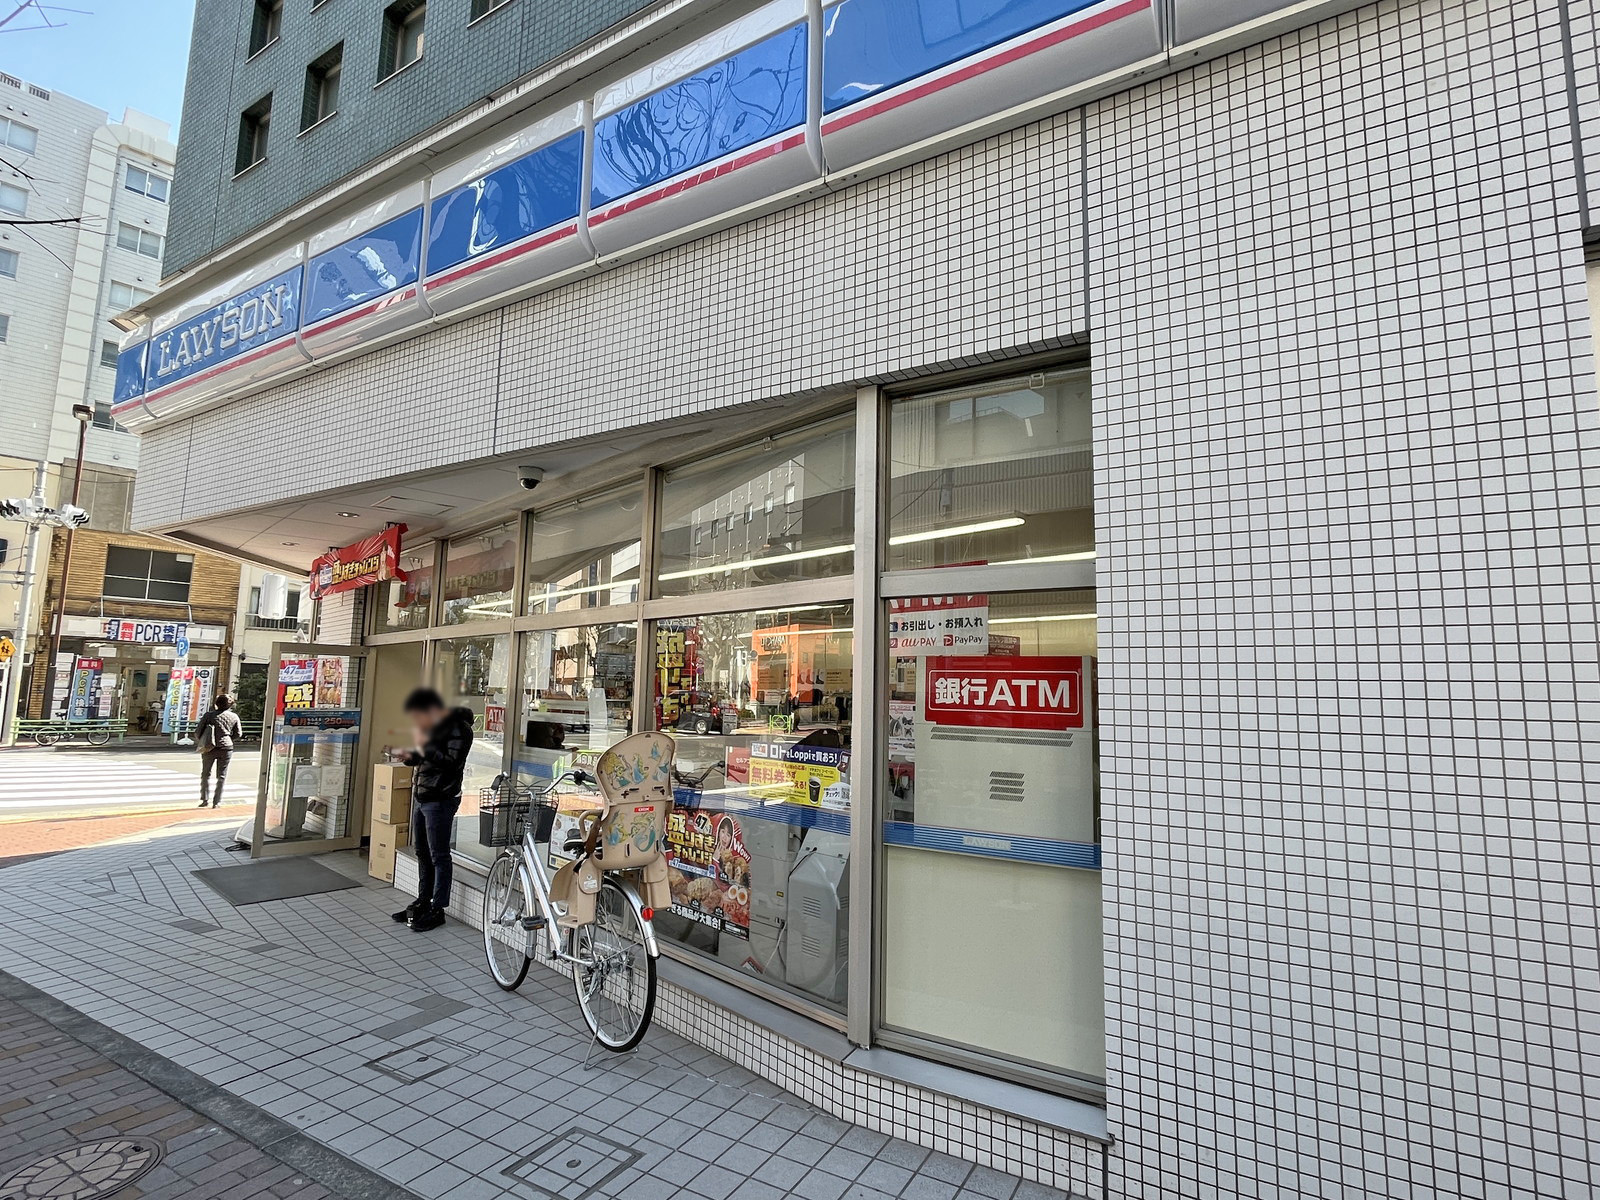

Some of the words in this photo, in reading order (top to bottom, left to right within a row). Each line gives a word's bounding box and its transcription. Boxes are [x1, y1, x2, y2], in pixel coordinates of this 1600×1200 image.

[157, 283, 287, 377] LAWSON
[901, 617, 983, 631] お引出し・お預入れ
[901, 638, 919, 647] au
[920, 637, 937, 646] PAY
[954, 635, 983, 645] PayPay
[935, 677, 1070, 708] 銀行ATM
[667, 814, 715, 852] 盛りすぎ
